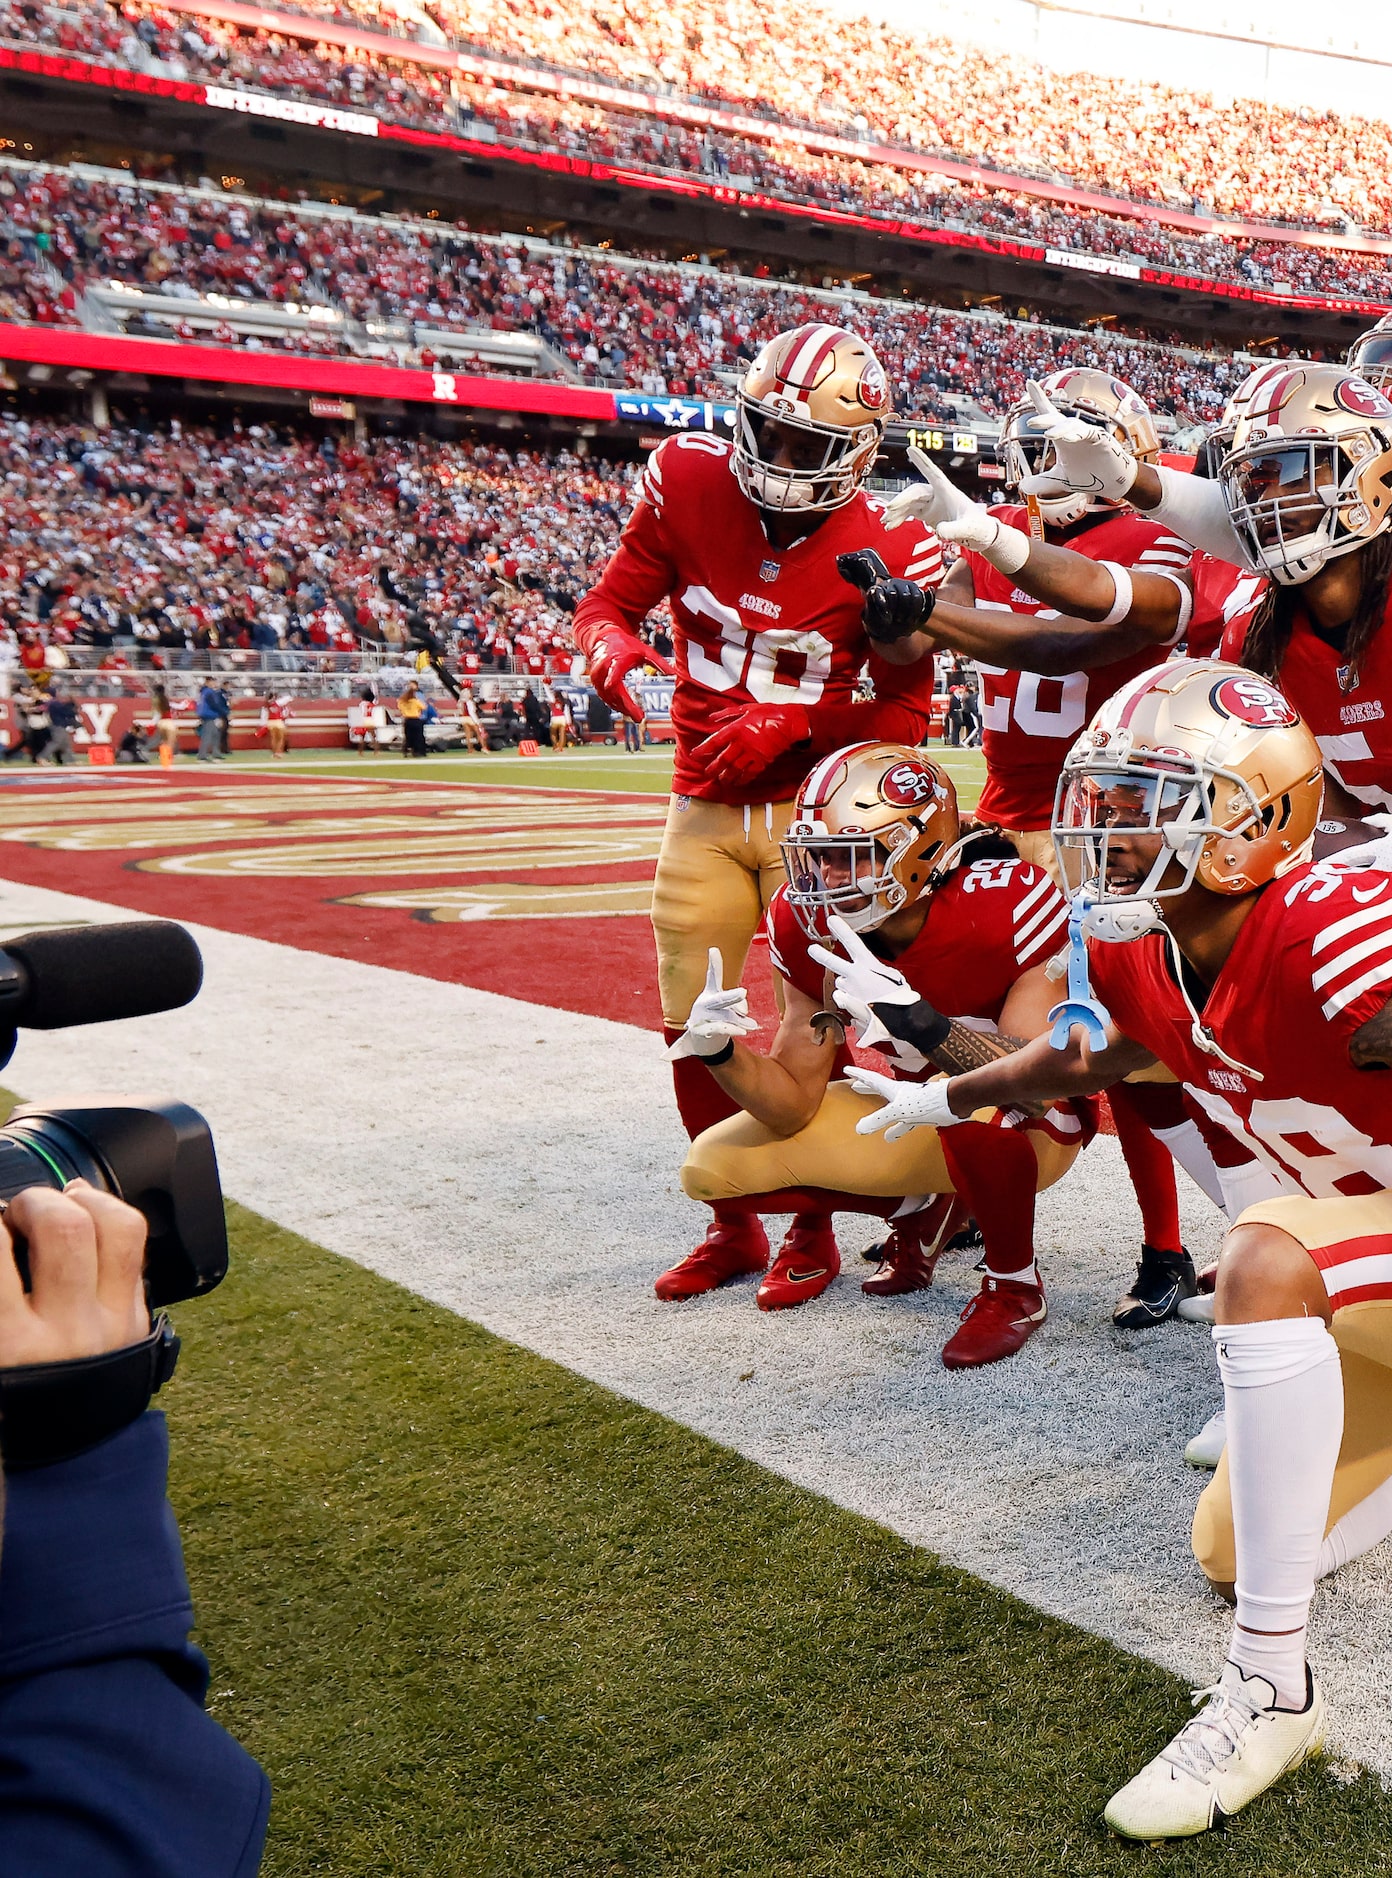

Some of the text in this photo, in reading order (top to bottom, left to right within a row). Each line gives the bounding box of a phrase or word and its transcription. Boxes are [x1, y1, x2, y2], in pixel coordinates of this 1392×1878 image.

[206, 85, 378, 137] INTERCEPTION
[1045, 248, 1141, 279] INTERCEPTION
[906, 429, 944, 450] 1:15
[738, 592, 782, 620] 49ERS
[680, 584, 834, 705] 30
[1339, 700, 1385, 725] 49ERS
[891, 766, 930, 801] SF
[1322, 824, 1336, 832] 135
[962, 858, 1020, 893] 29
